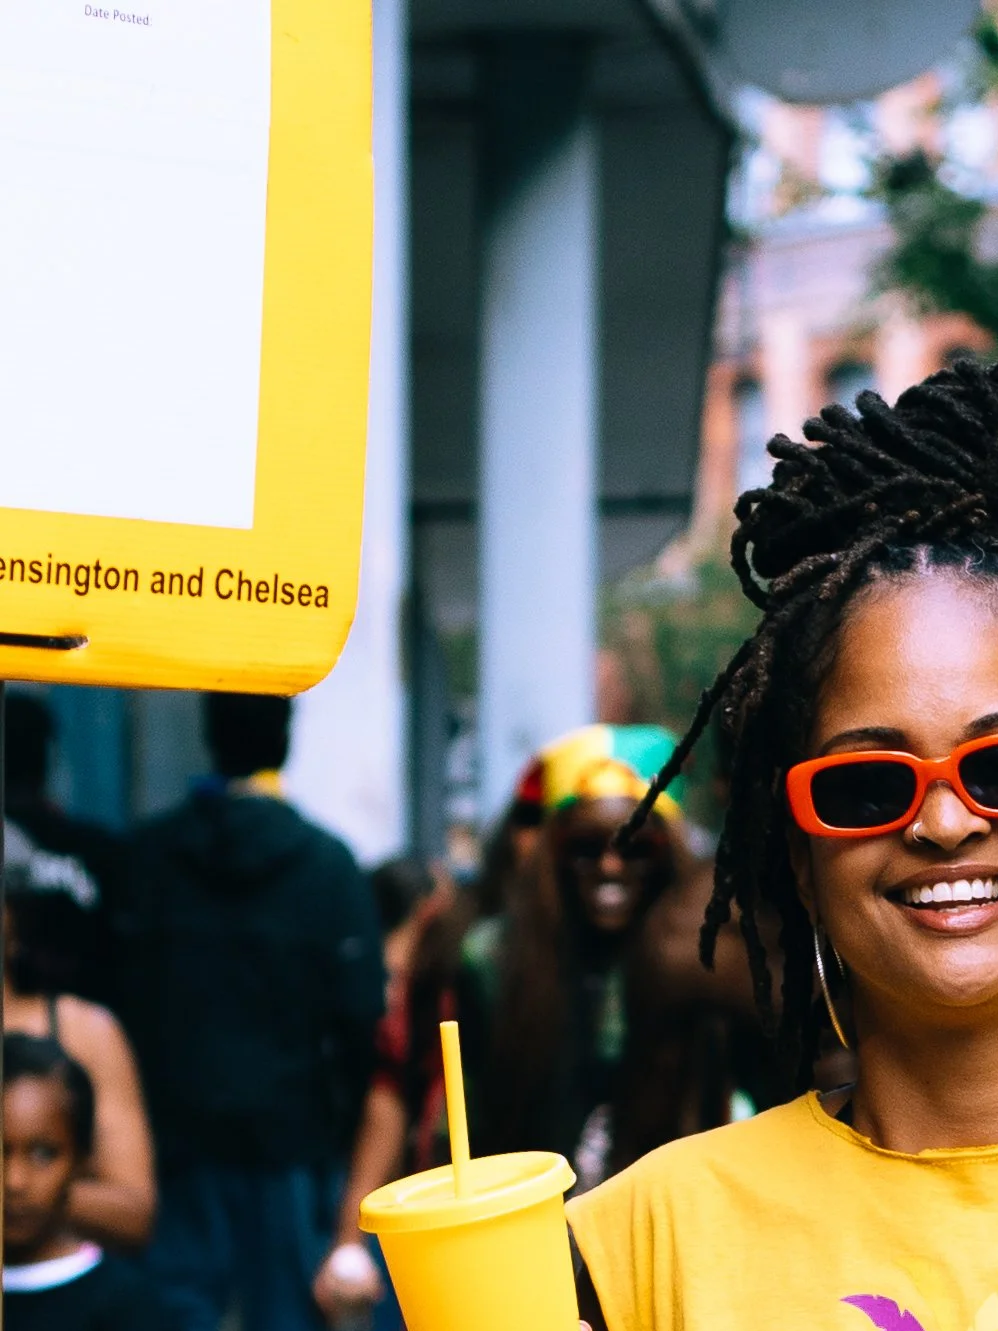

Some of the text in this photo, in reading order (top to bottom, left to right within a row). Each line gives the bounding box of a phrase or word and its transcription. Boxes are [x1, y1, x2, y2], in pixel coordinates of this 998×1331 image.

[84, 4, 110, 19] Date
[150, 567, 204, 598] and
[214, 568, 330, 609] Chelsea
